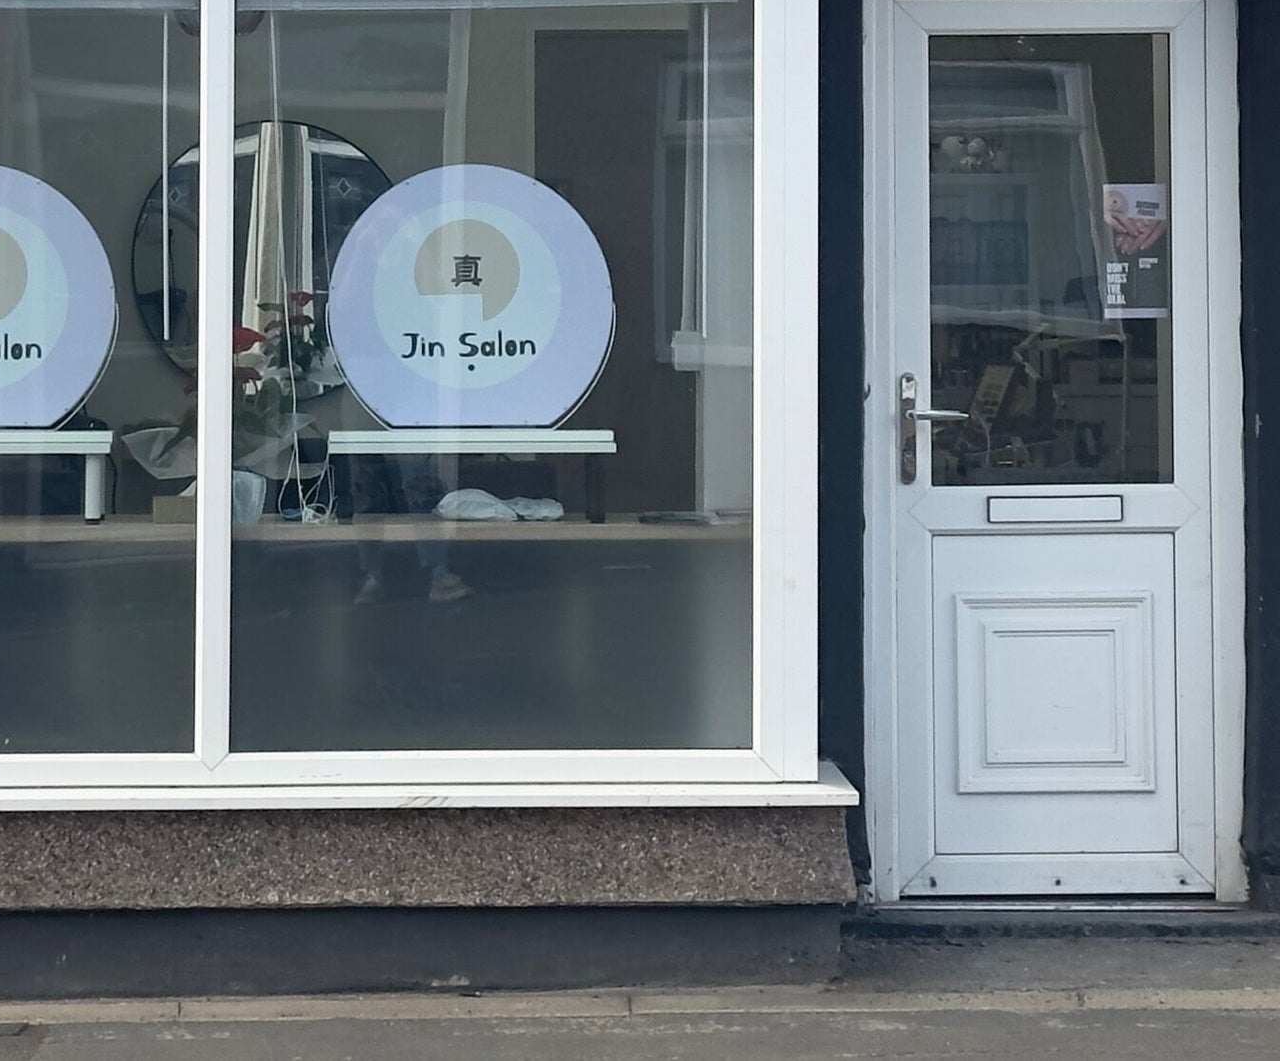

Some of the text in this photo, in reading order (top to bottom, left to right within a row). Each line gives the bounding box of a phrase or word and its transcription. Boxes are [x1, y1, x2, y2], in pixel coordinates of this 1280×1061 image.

[451, 254, 482, 287] 真
[401, 329, 536, 358] Jin Salon
